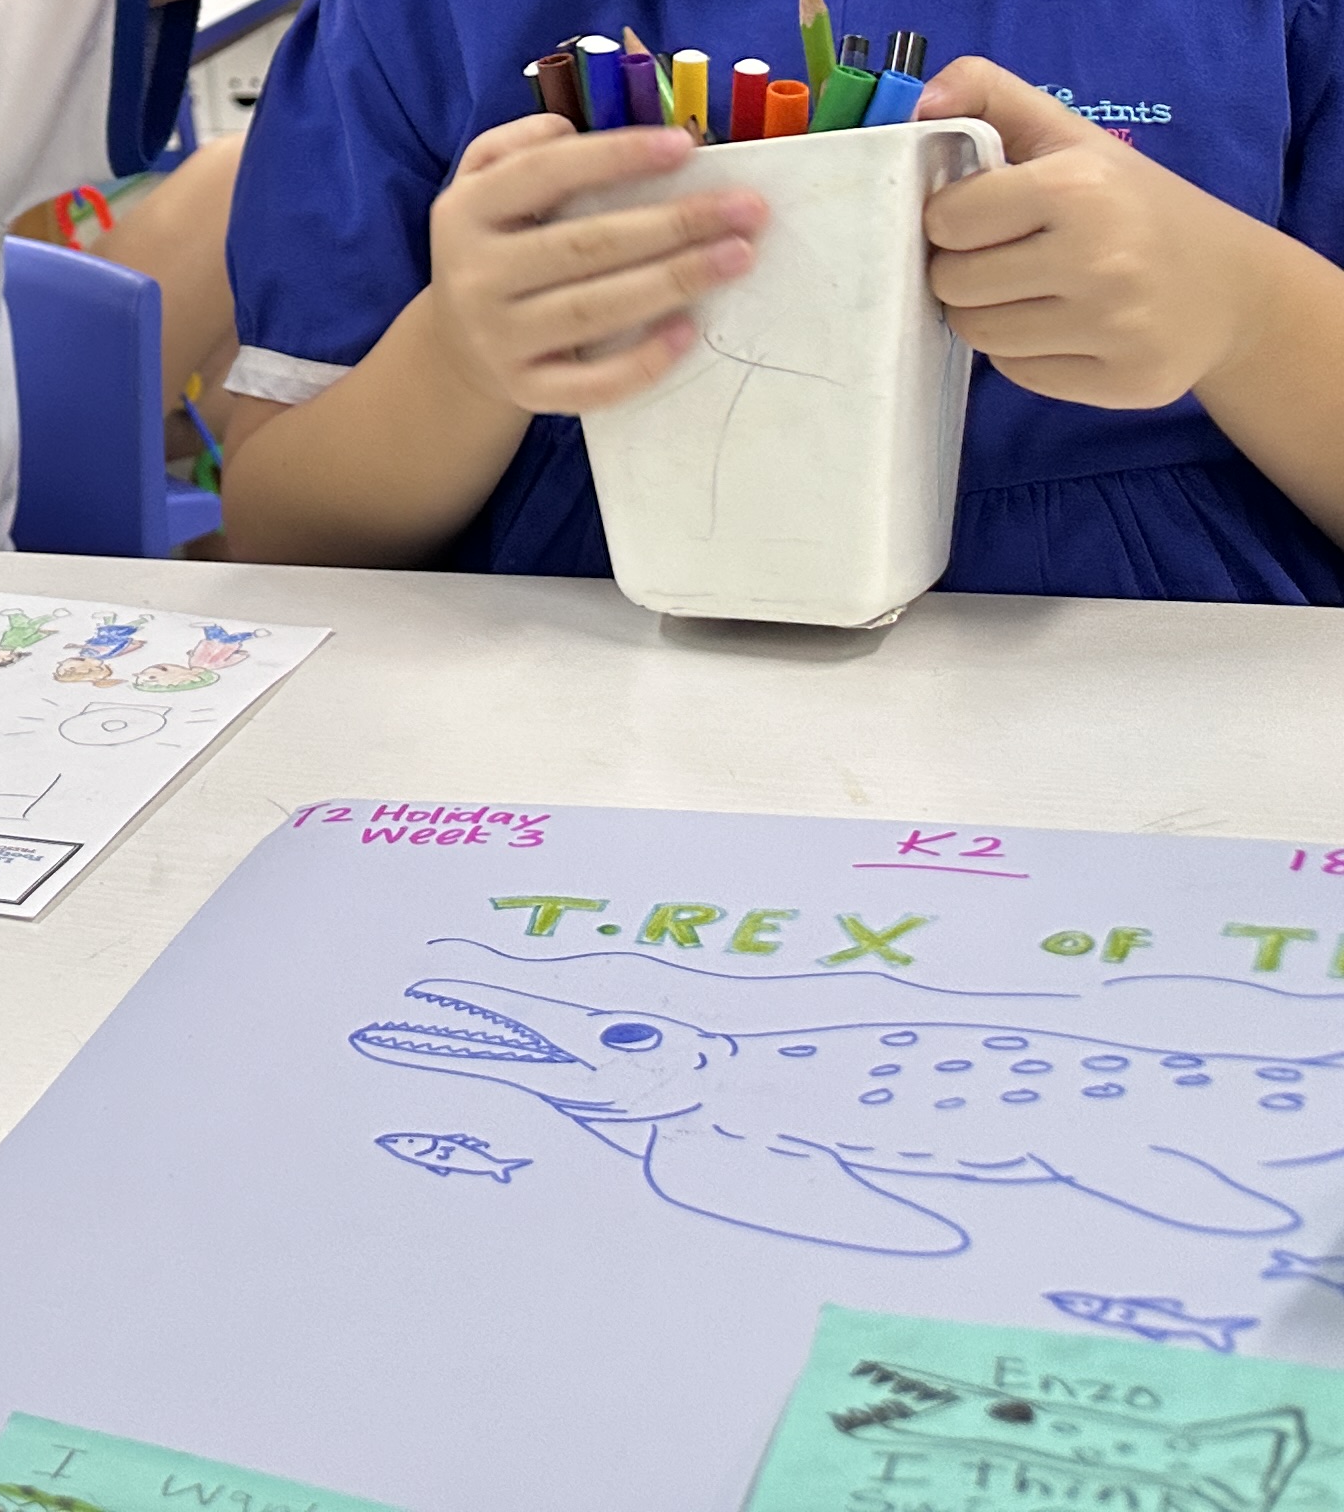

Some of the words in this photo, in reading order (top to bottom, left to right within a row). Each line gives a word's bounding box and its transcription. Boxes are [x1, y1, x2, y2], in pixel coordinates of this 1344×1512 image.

[1065, 99, 1172, 124] prints
[293, 802, 354, 828] T2
[370, 803, 552, 831] Holiday
[361, 825, 492, 846] Week
[508, 829, 546, 848] 3
[897, 829, 1006, 858] K2
[490, 893, 939, 968] T.REX
[1219, 921, 1344, 979] T
[993, 1354, 1164, 1409] Enzo
[33, 1443, 88, 1481] I
[869, 1450, 931, 1484] I
